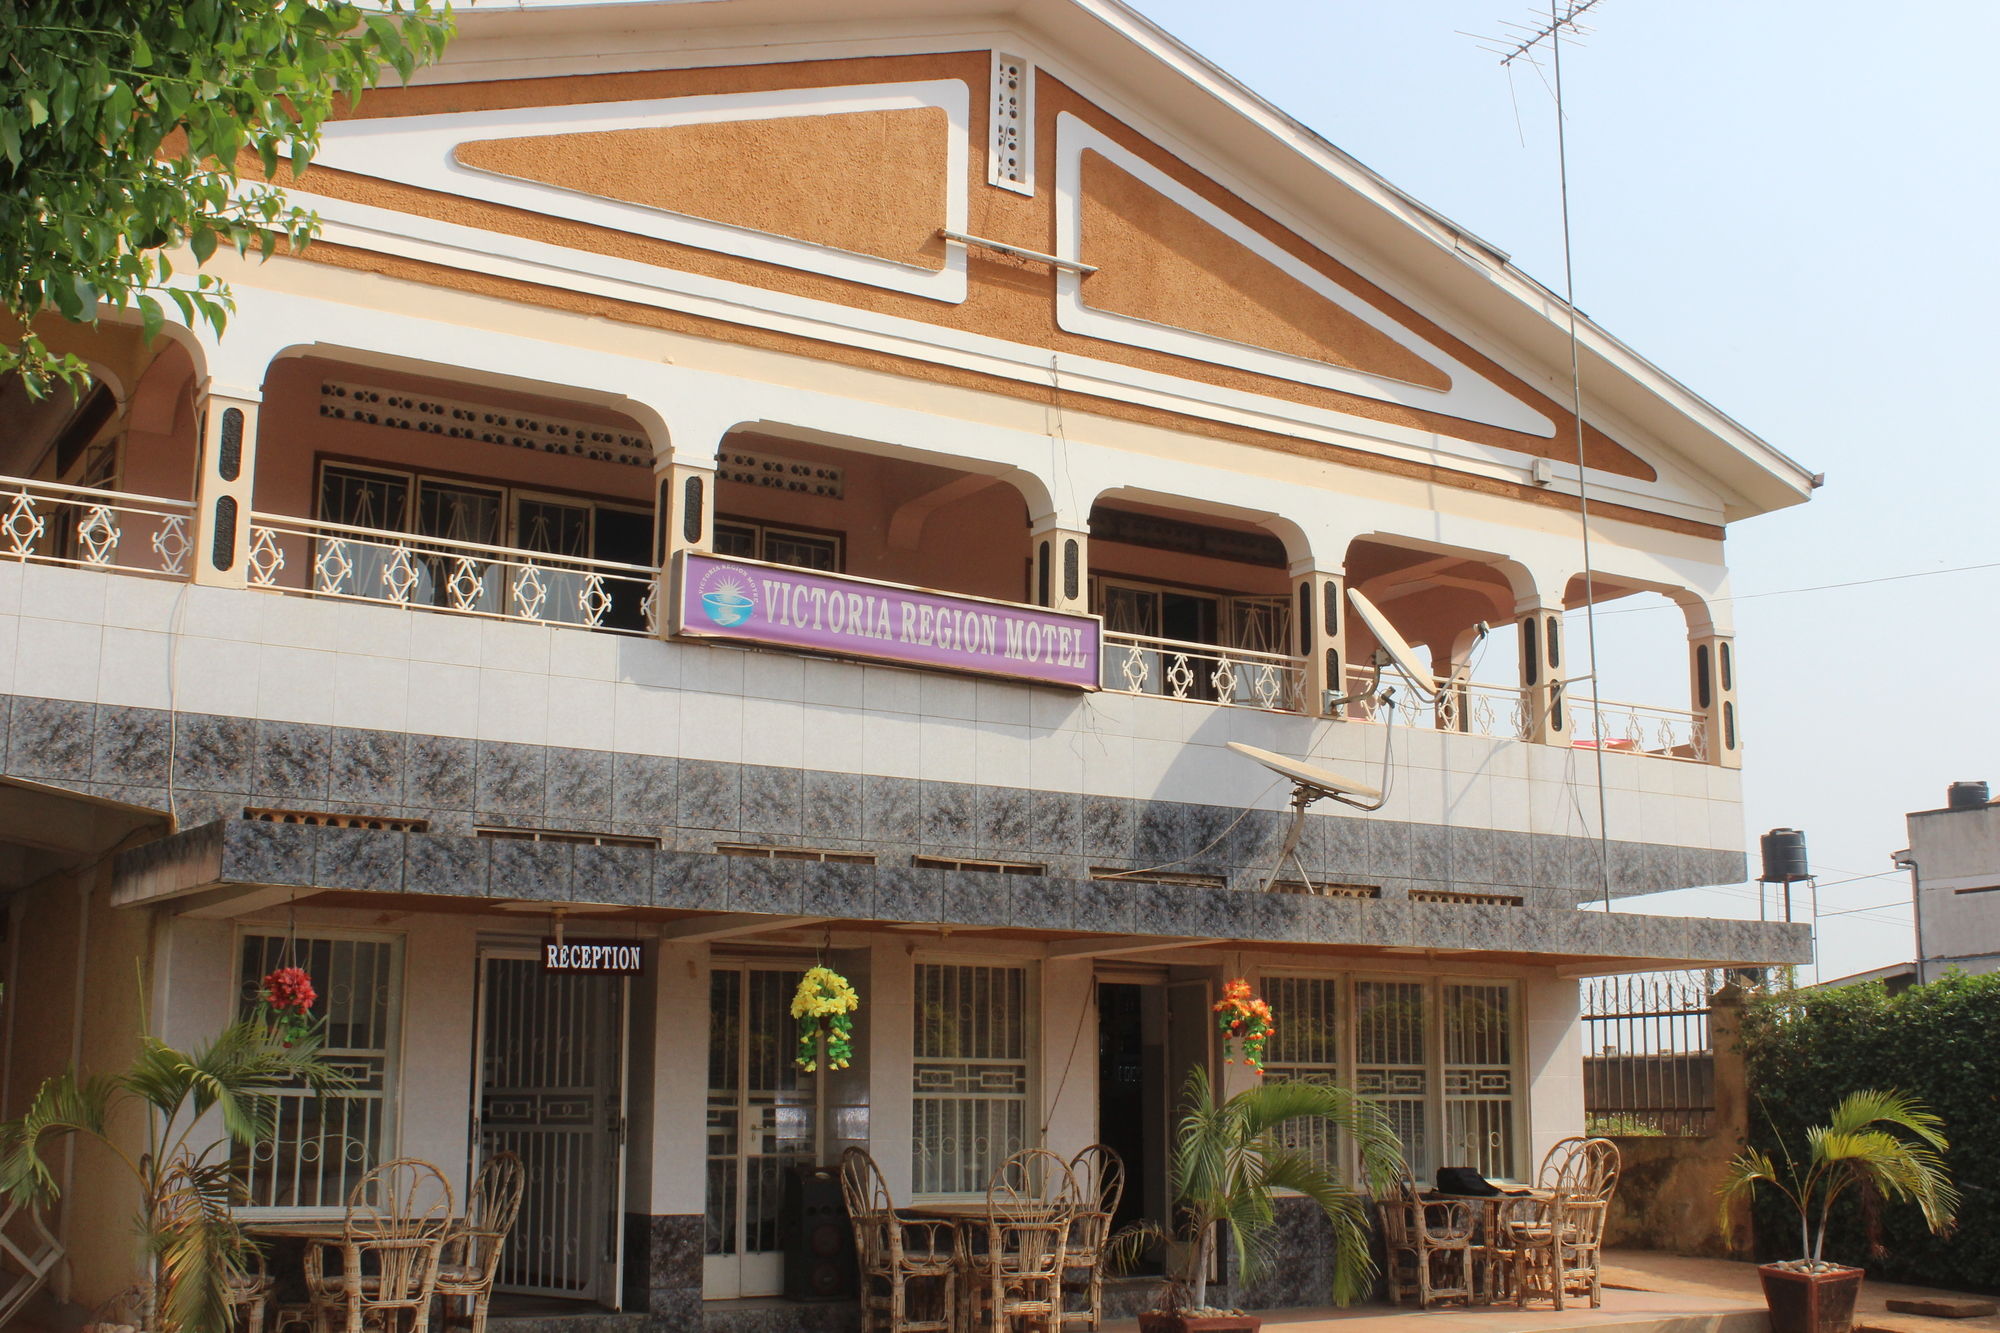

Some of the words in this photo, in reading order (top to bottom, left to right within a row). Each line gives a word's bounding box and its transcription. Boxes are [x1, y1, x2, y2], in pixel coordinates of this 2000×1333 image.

[763, 579, 893, 641] VICTORIA
[900, 601, 997, 656] REGION
[1004, 618, 1087, 669] MOTEL
[546, 944, 641, 970] RECEPTION
